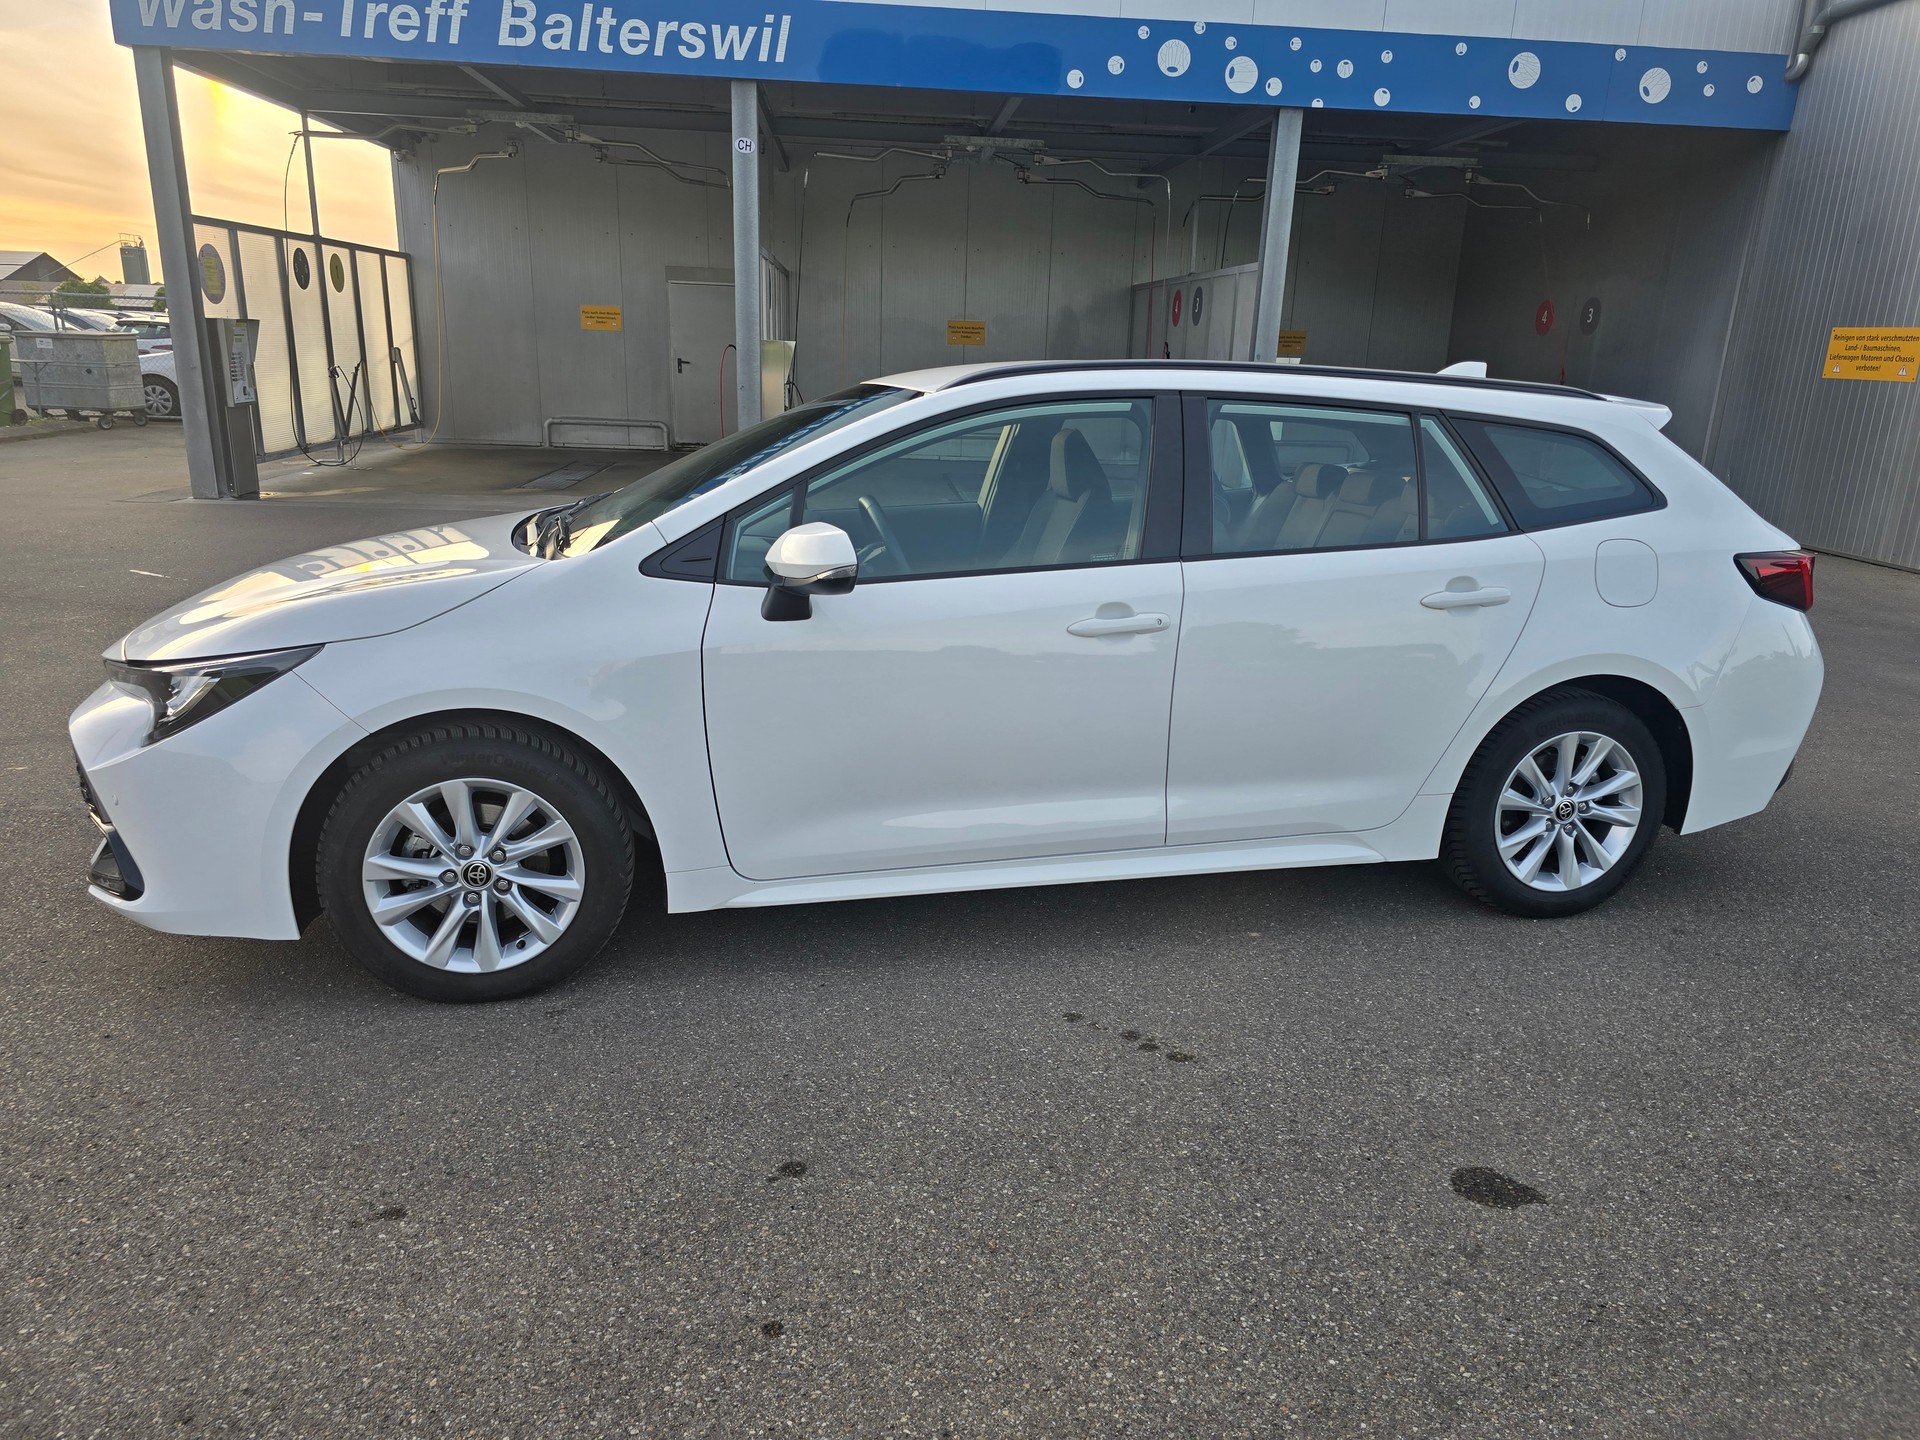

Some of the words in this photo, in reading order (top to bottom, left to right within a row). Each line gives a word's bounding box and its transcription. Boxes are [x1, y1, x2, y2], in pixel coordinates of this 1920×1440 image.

[498, 0, 792, 63] Balterswil
[738, 139, 752, 151] CH
[1194, 298, 1200, 313] 3
[1541, 310, 1548, 324] 4
[1587, 308, 1594, 323] 3
[1834, 334, 1855, 342] Reinigen
[1863, 344, 1902, 352] Baumaschinen,
[1829, 353, 1859, 362] Lieferwagen
[1861, 354, 1883, 362] Motoren
[1895, 355, 1915, 363] Chassis
[1855, 364, 1881, 372] verboten!
